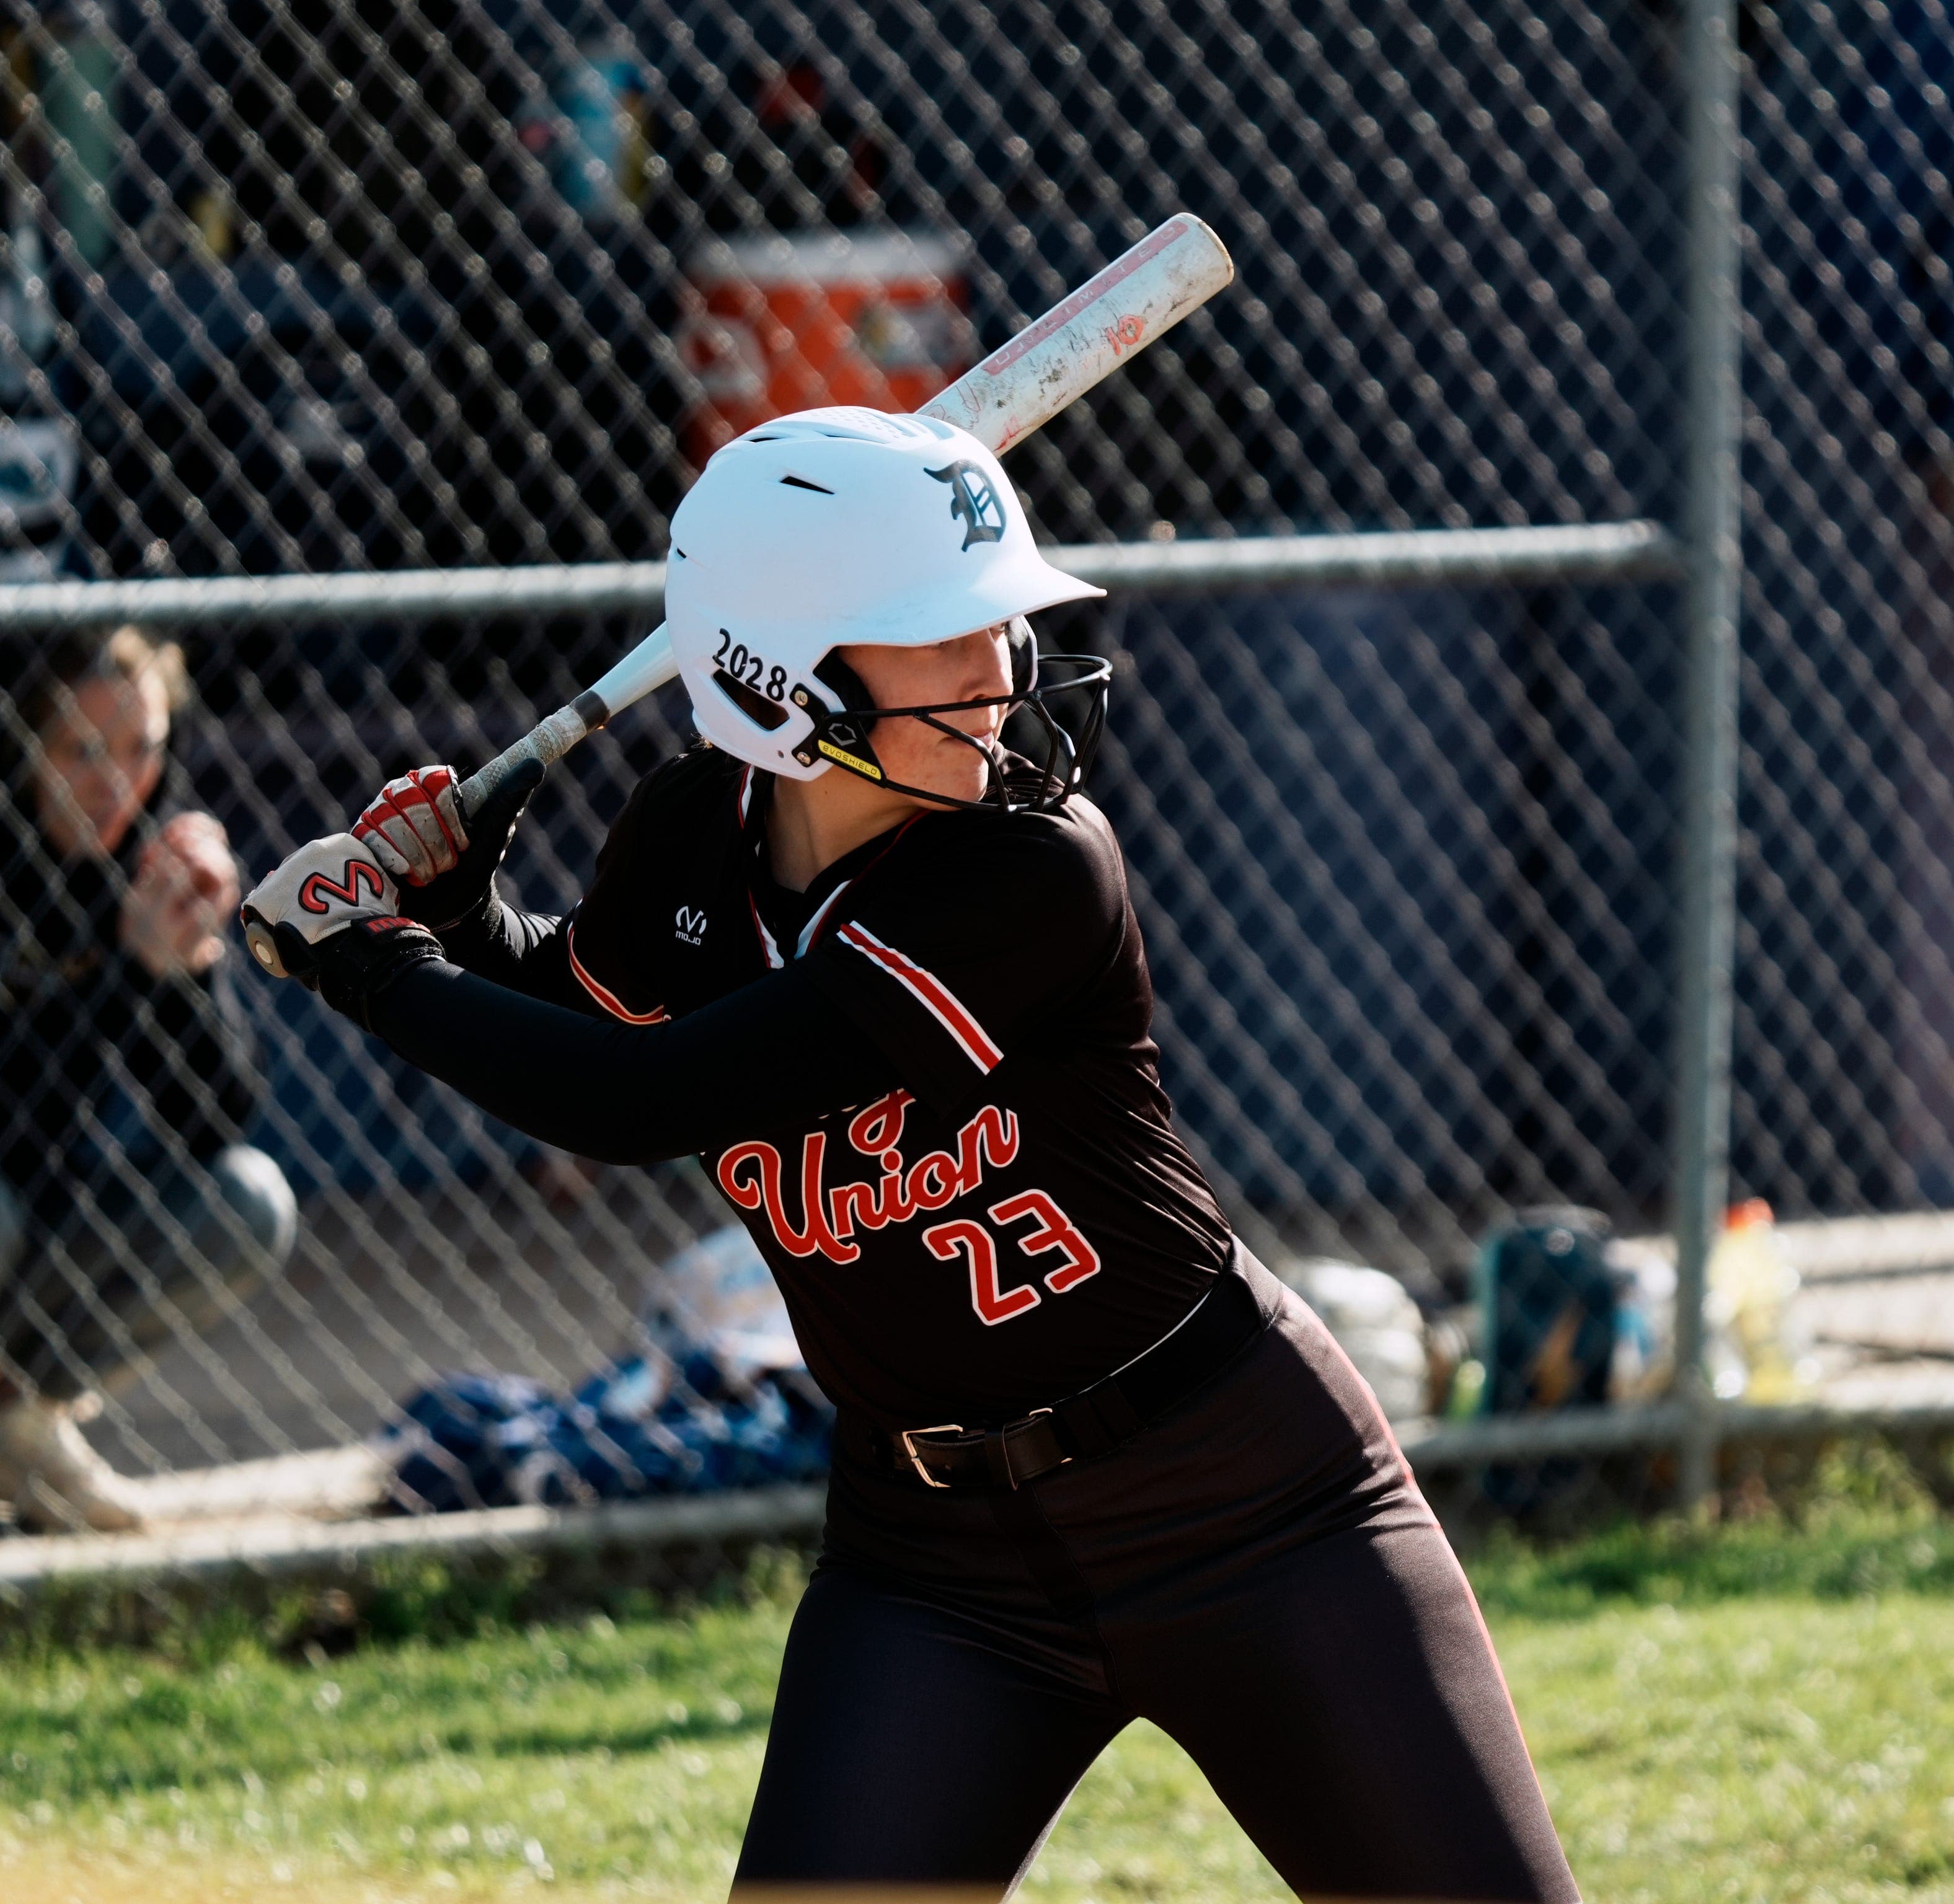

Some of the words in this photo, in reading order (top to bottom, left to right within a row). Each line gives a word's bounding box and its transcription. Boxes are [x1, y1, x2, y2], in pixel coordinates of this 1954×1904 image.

[995, 227, 1175, 366] UNLIMTED
[923, 459, 1007, 553] D
[712, 628, 787, 702] 2028
[717, 1104, 1020, 1264] Union
[922, 1189, 1101, 1326] 23
